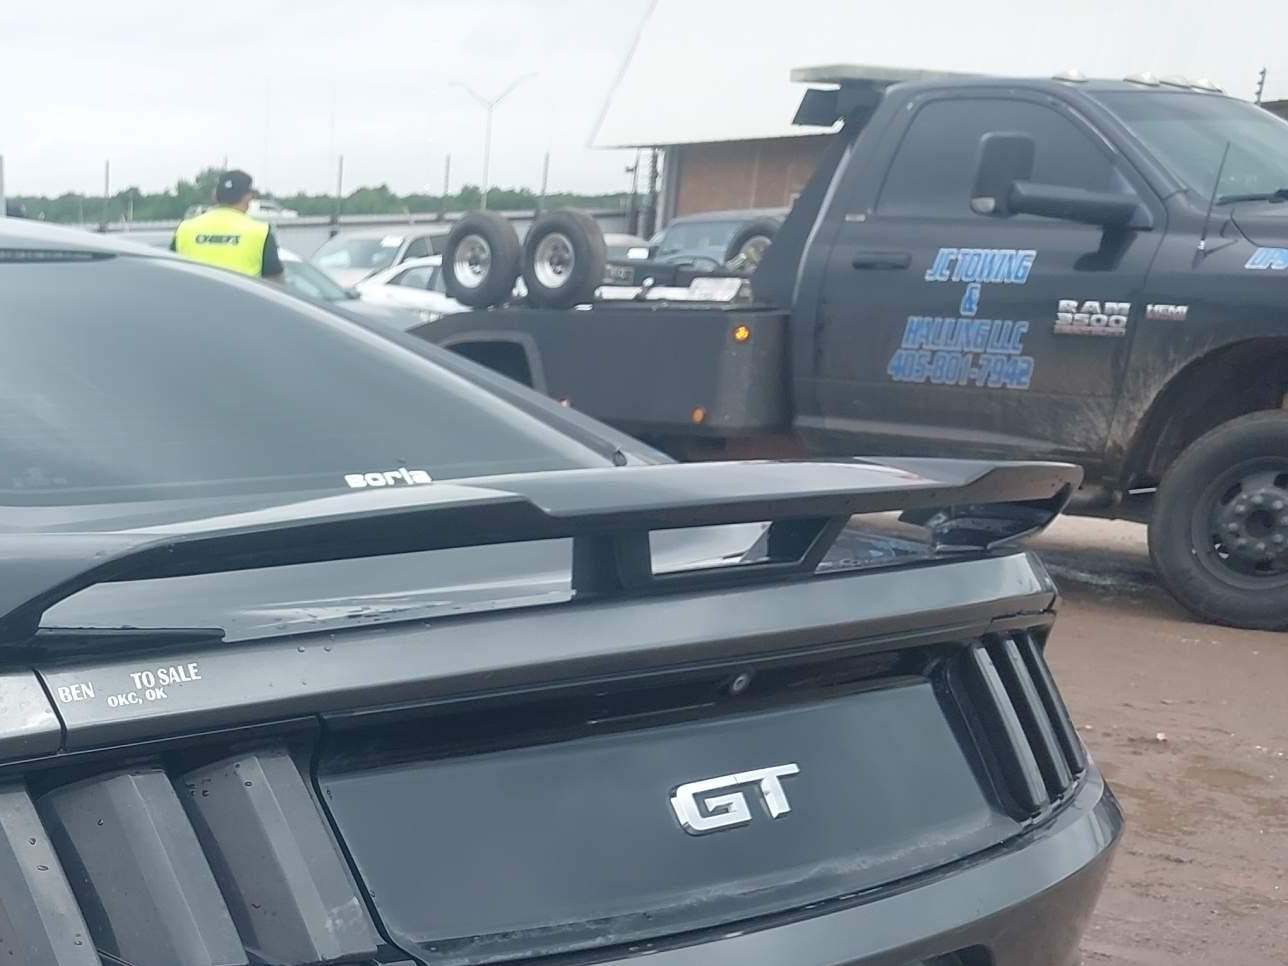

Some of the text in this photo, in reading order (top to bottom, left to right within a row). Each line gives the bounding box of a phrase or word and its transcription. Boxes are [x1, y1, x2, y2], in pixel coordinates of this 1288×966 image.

[925, 248, 1037, 284] JC TOWING
[960, 283, 981, 316] &
[1058, 300, 1132, 314] RAM
[1146, 304, 1189, 321] HEMI
[986, 319, 1030, 354] LLC
[1055, 313, 1128, 328] 3500
[57, 663, 202, 703] BEN TO SALE
[107, 687, 167, 707] OKC, OK
[670, 763, 800, 836] GT
